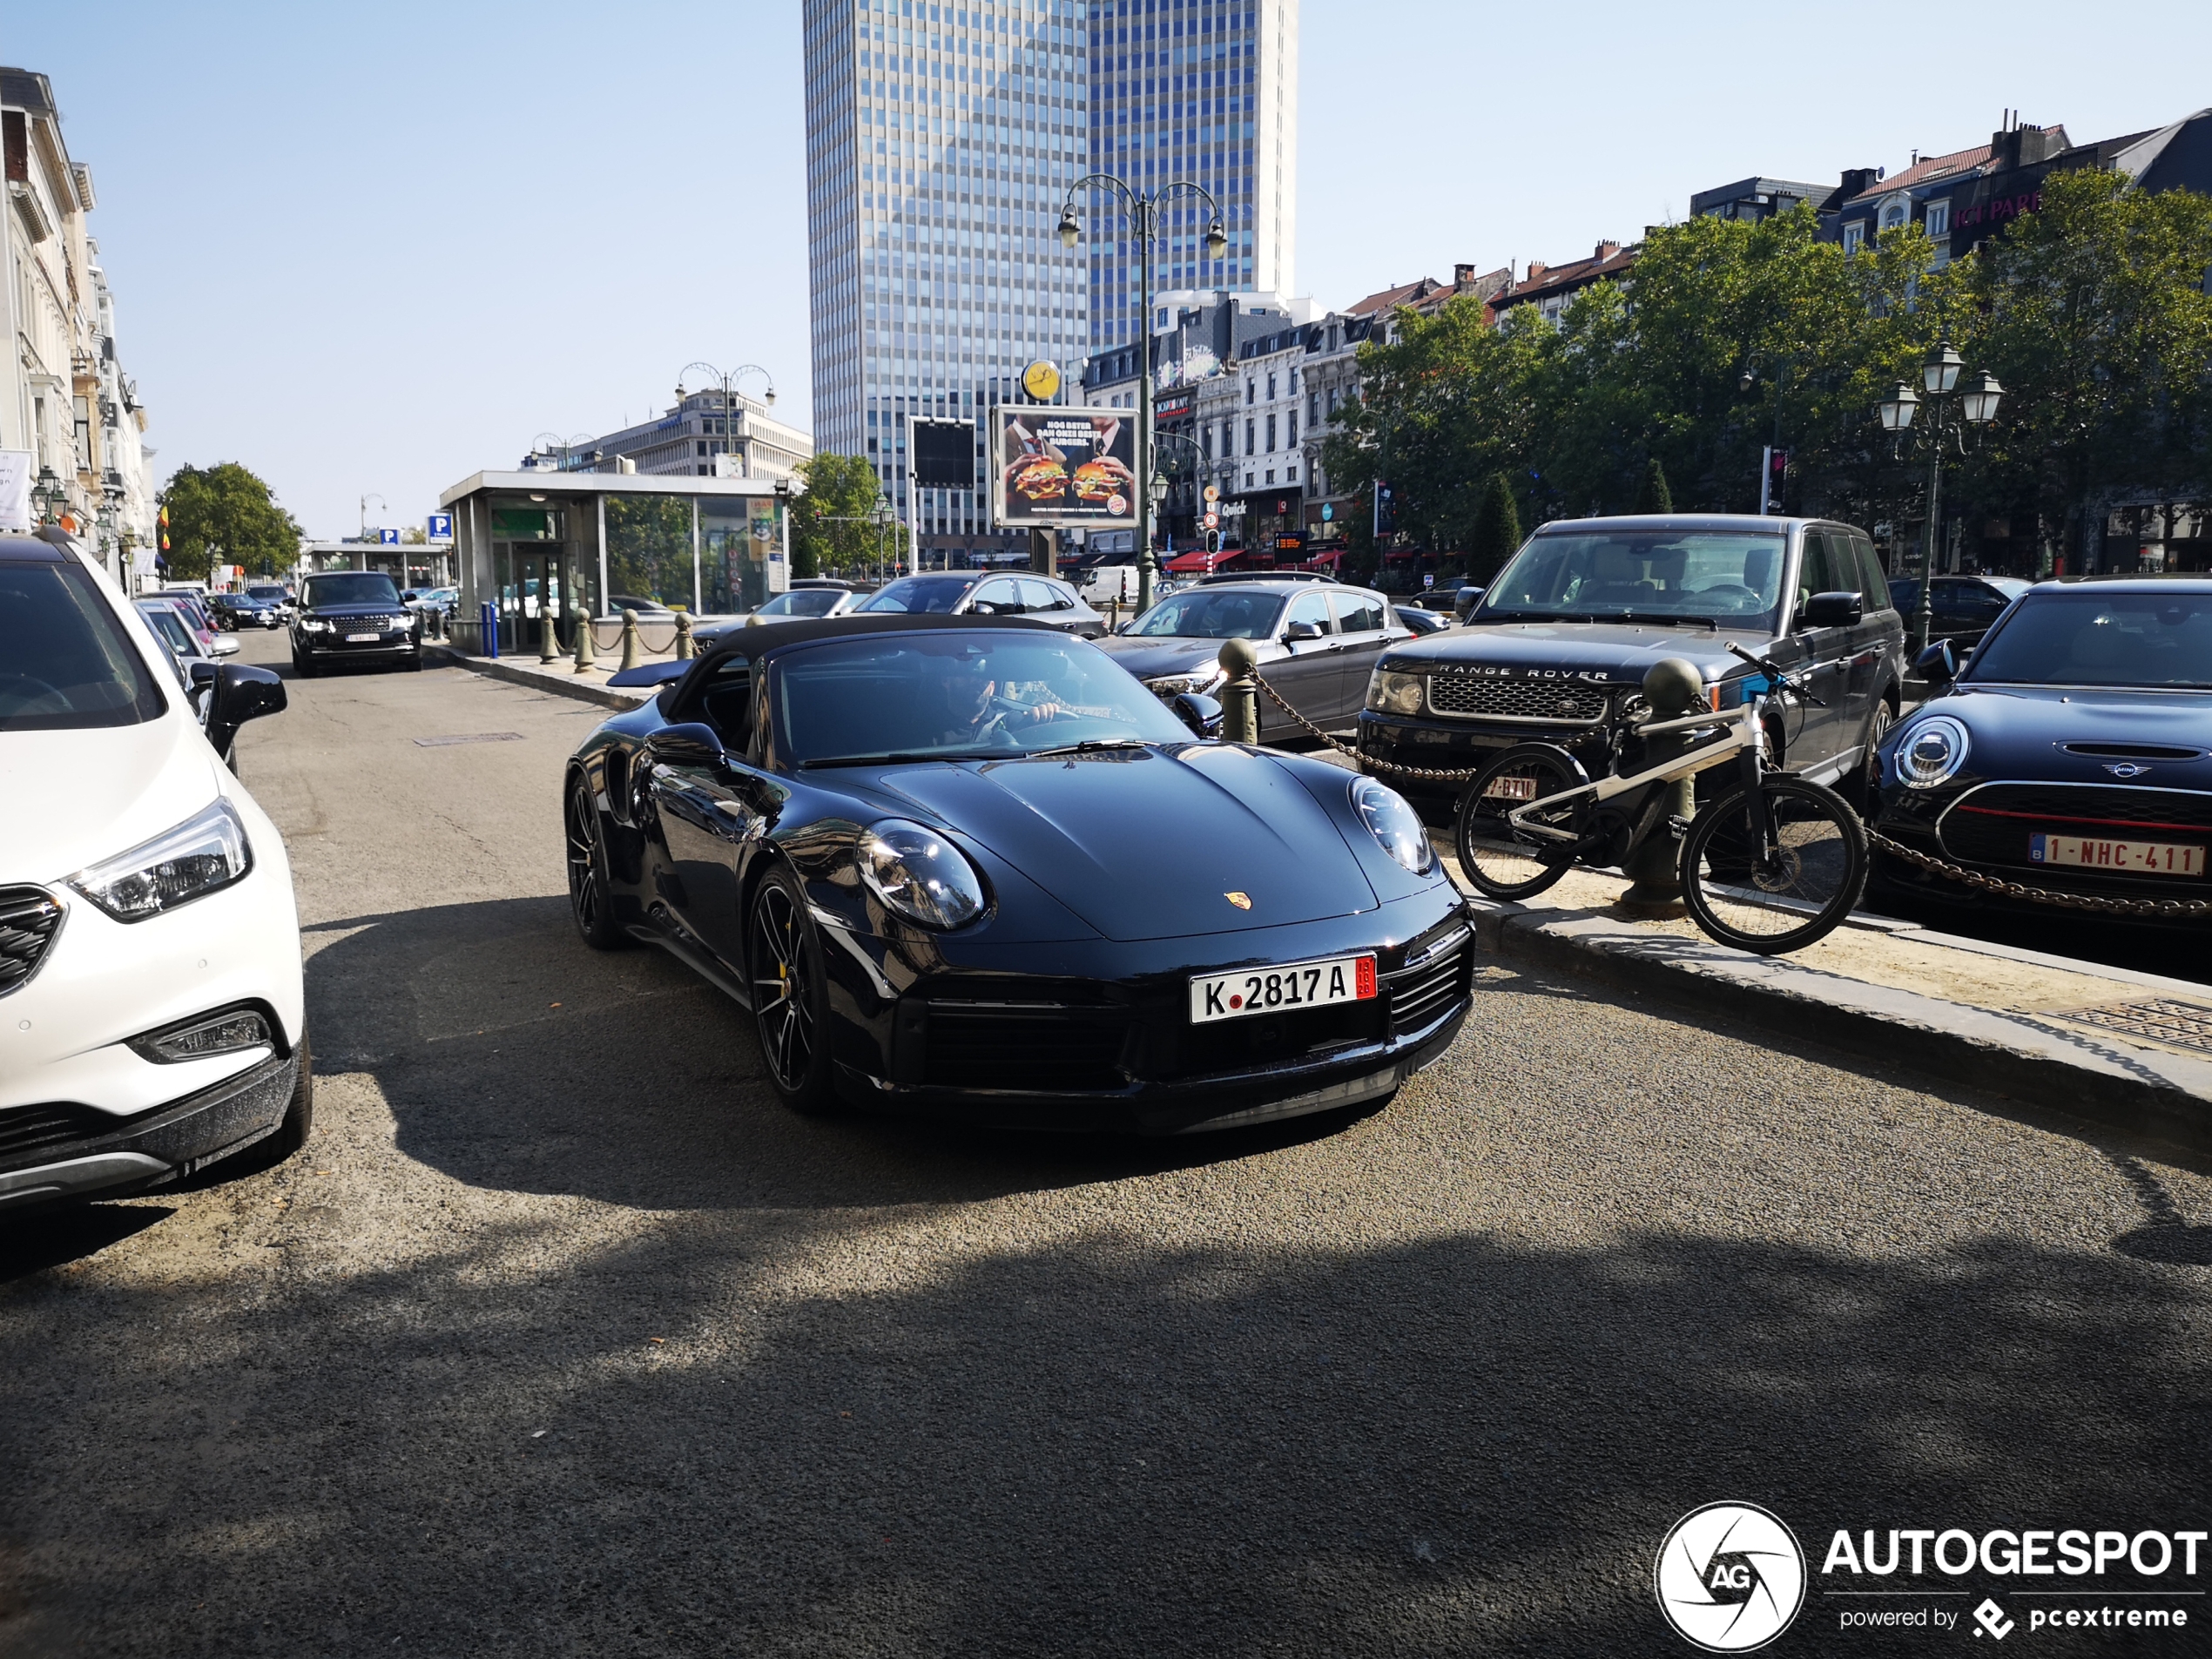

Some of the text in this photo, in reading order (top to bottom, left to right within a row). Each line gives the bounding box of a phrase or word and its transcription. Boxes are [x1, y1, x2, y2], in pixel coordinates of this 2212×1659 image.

[1954, 206, 1982, 228] ICI
[1066, 421, 1091, 430] BETER
[1222, 500, 1247, 517] Quick
[1280, 501, 1287, 510] Q
[435, 517, 448, 532] P
[385, 530, 395, 542] P
[1439, 665, 1608, 679] RANGE ROVER
[2032, 838, 2191, 871] B 1-NHC-411
[1358, 961, 1370, 973] 13
[1205, 966, 1346, 1016] K 2817 A
[1358, 984, 1370, 995] 20
